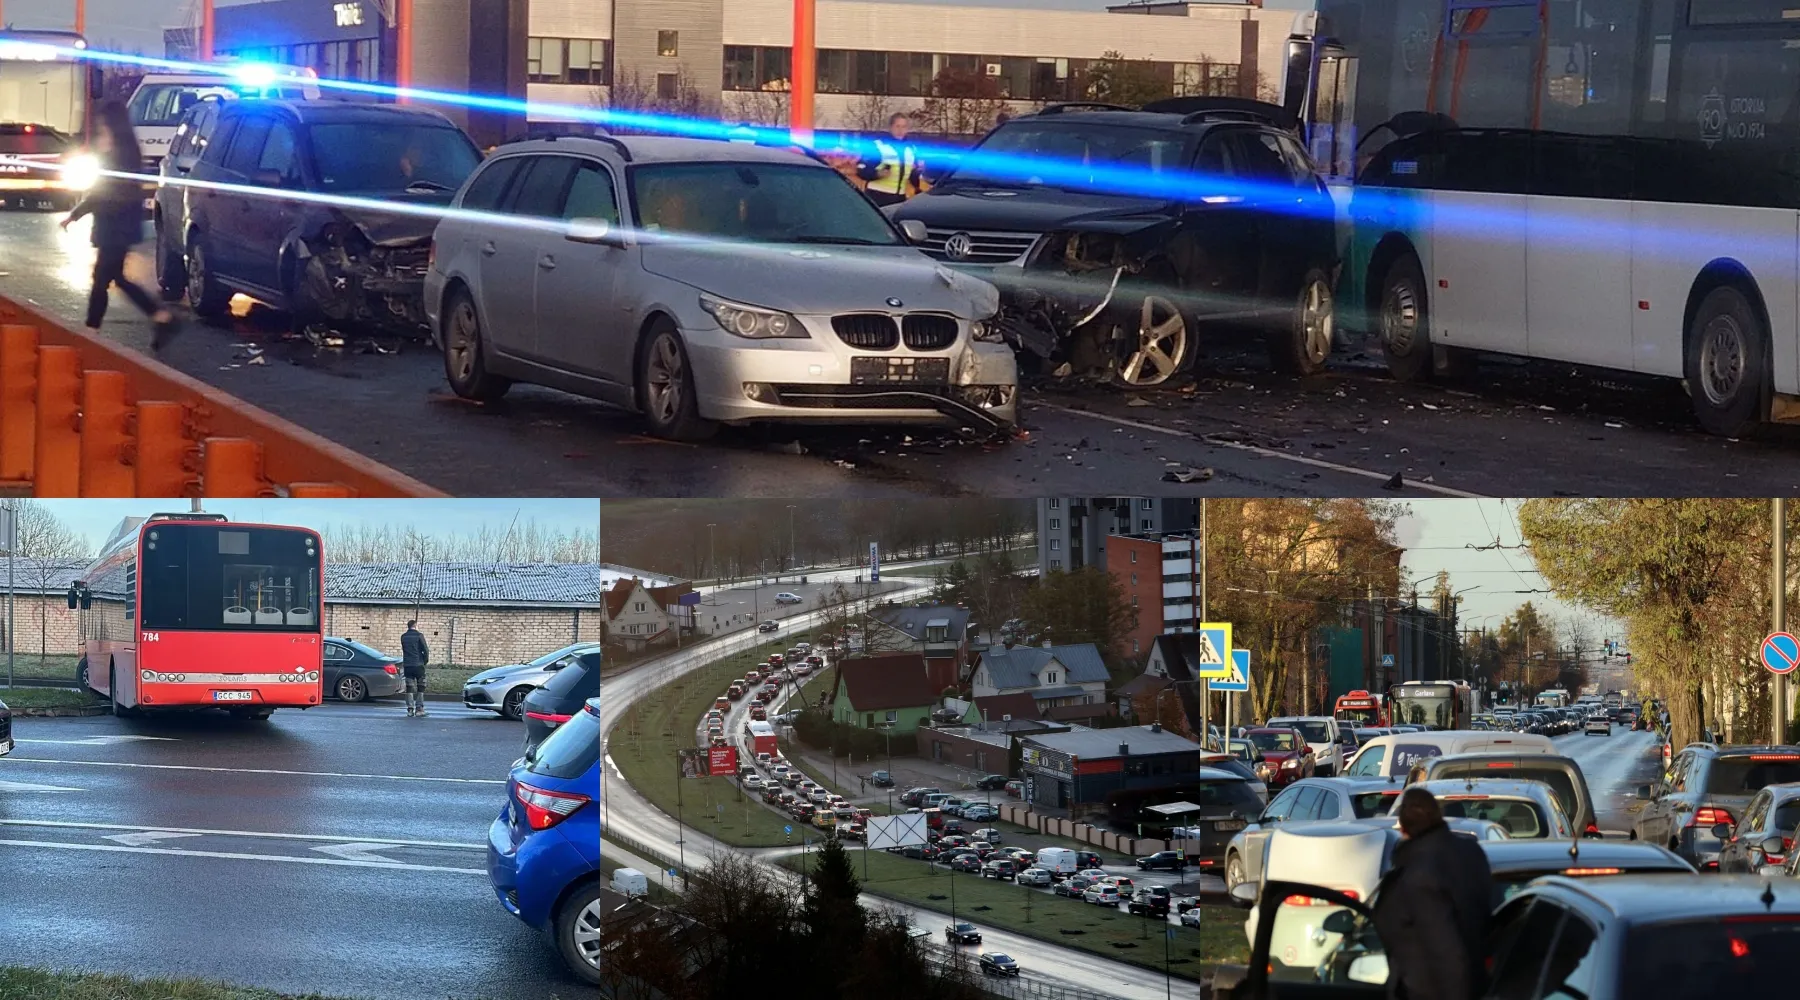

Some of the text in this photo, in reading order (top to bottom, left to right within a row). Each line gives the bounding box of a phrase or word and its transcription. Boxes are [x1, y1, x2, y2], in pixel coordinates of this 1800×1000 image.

[143, 633, 160, 642] 784
[218, 692, 251, 700] GCC 945
[1406, 753, 1422, 767] Teli
